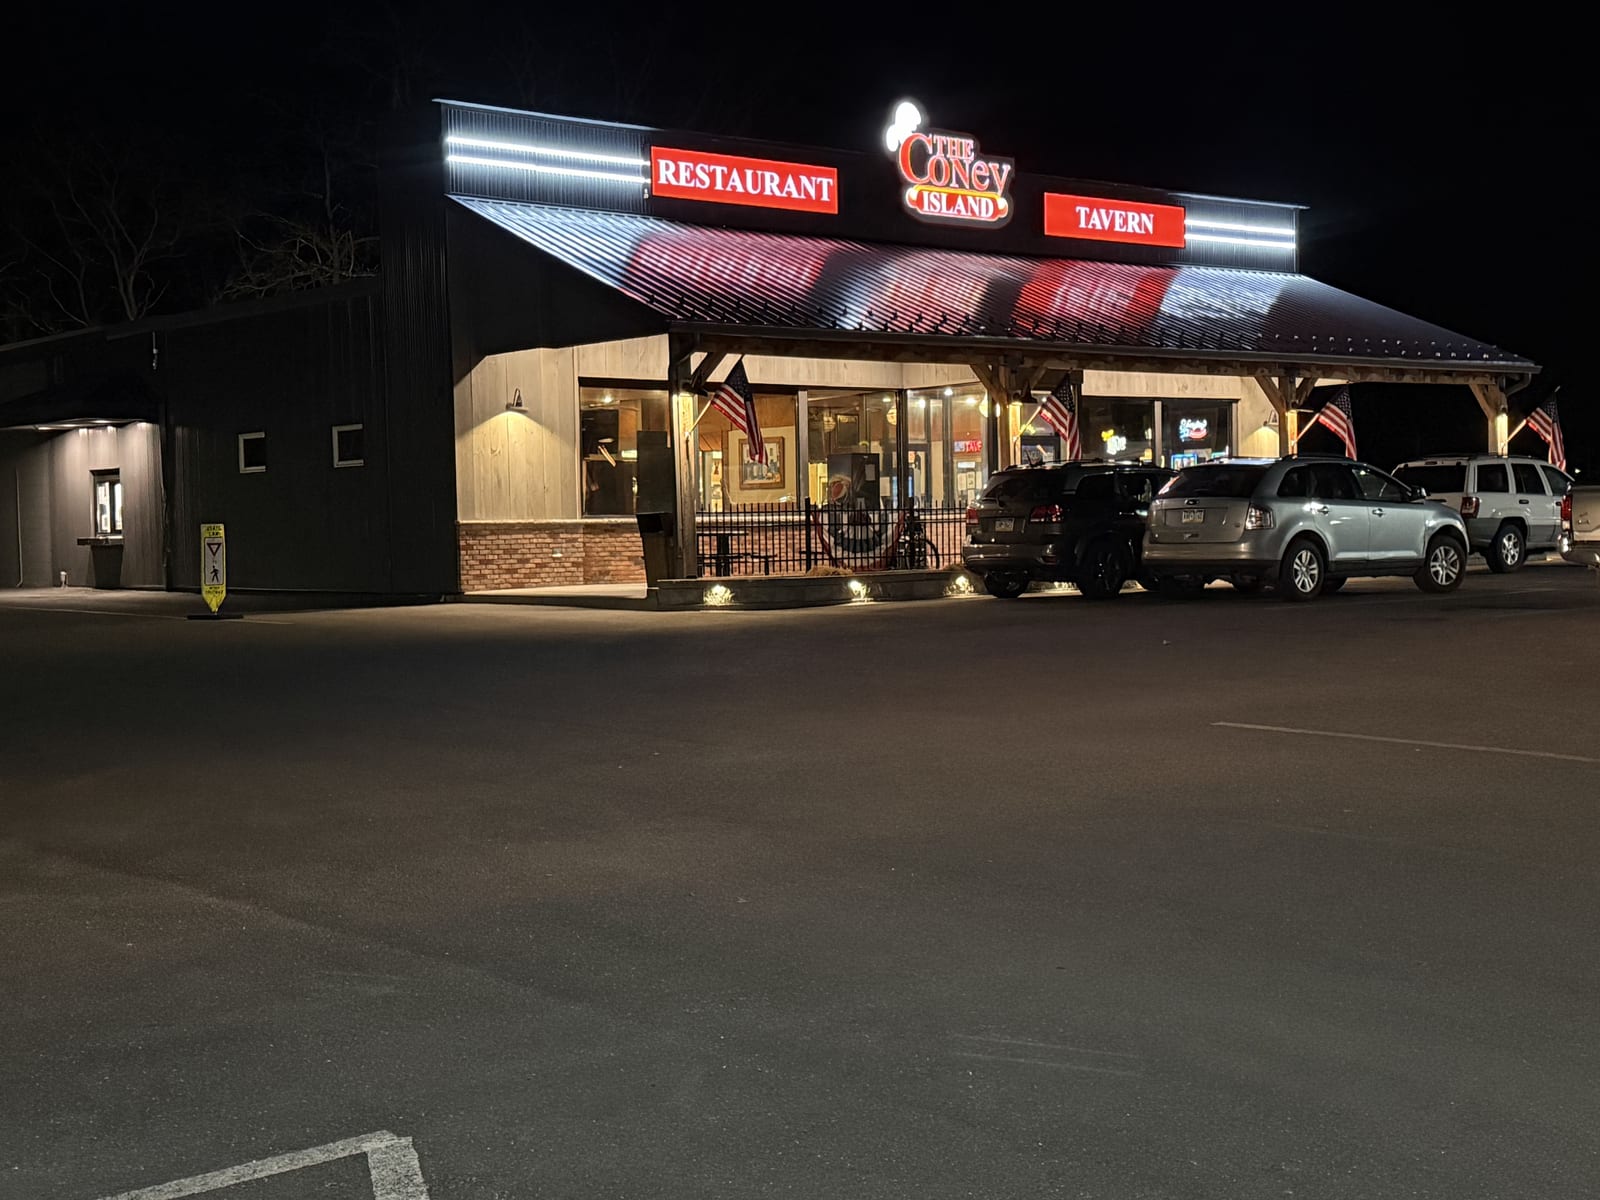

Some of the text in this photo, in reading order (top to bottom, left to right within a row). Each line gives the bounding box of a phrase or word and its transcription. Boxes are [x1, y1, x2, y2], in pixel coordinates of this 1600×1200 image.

[933, 134, 974, 161] THE
[657, 158, 833, 202] RESTAURANT
[922, 190, 995, 218] ISLAND
[1075, 205, 1155, 235] TAVERN
